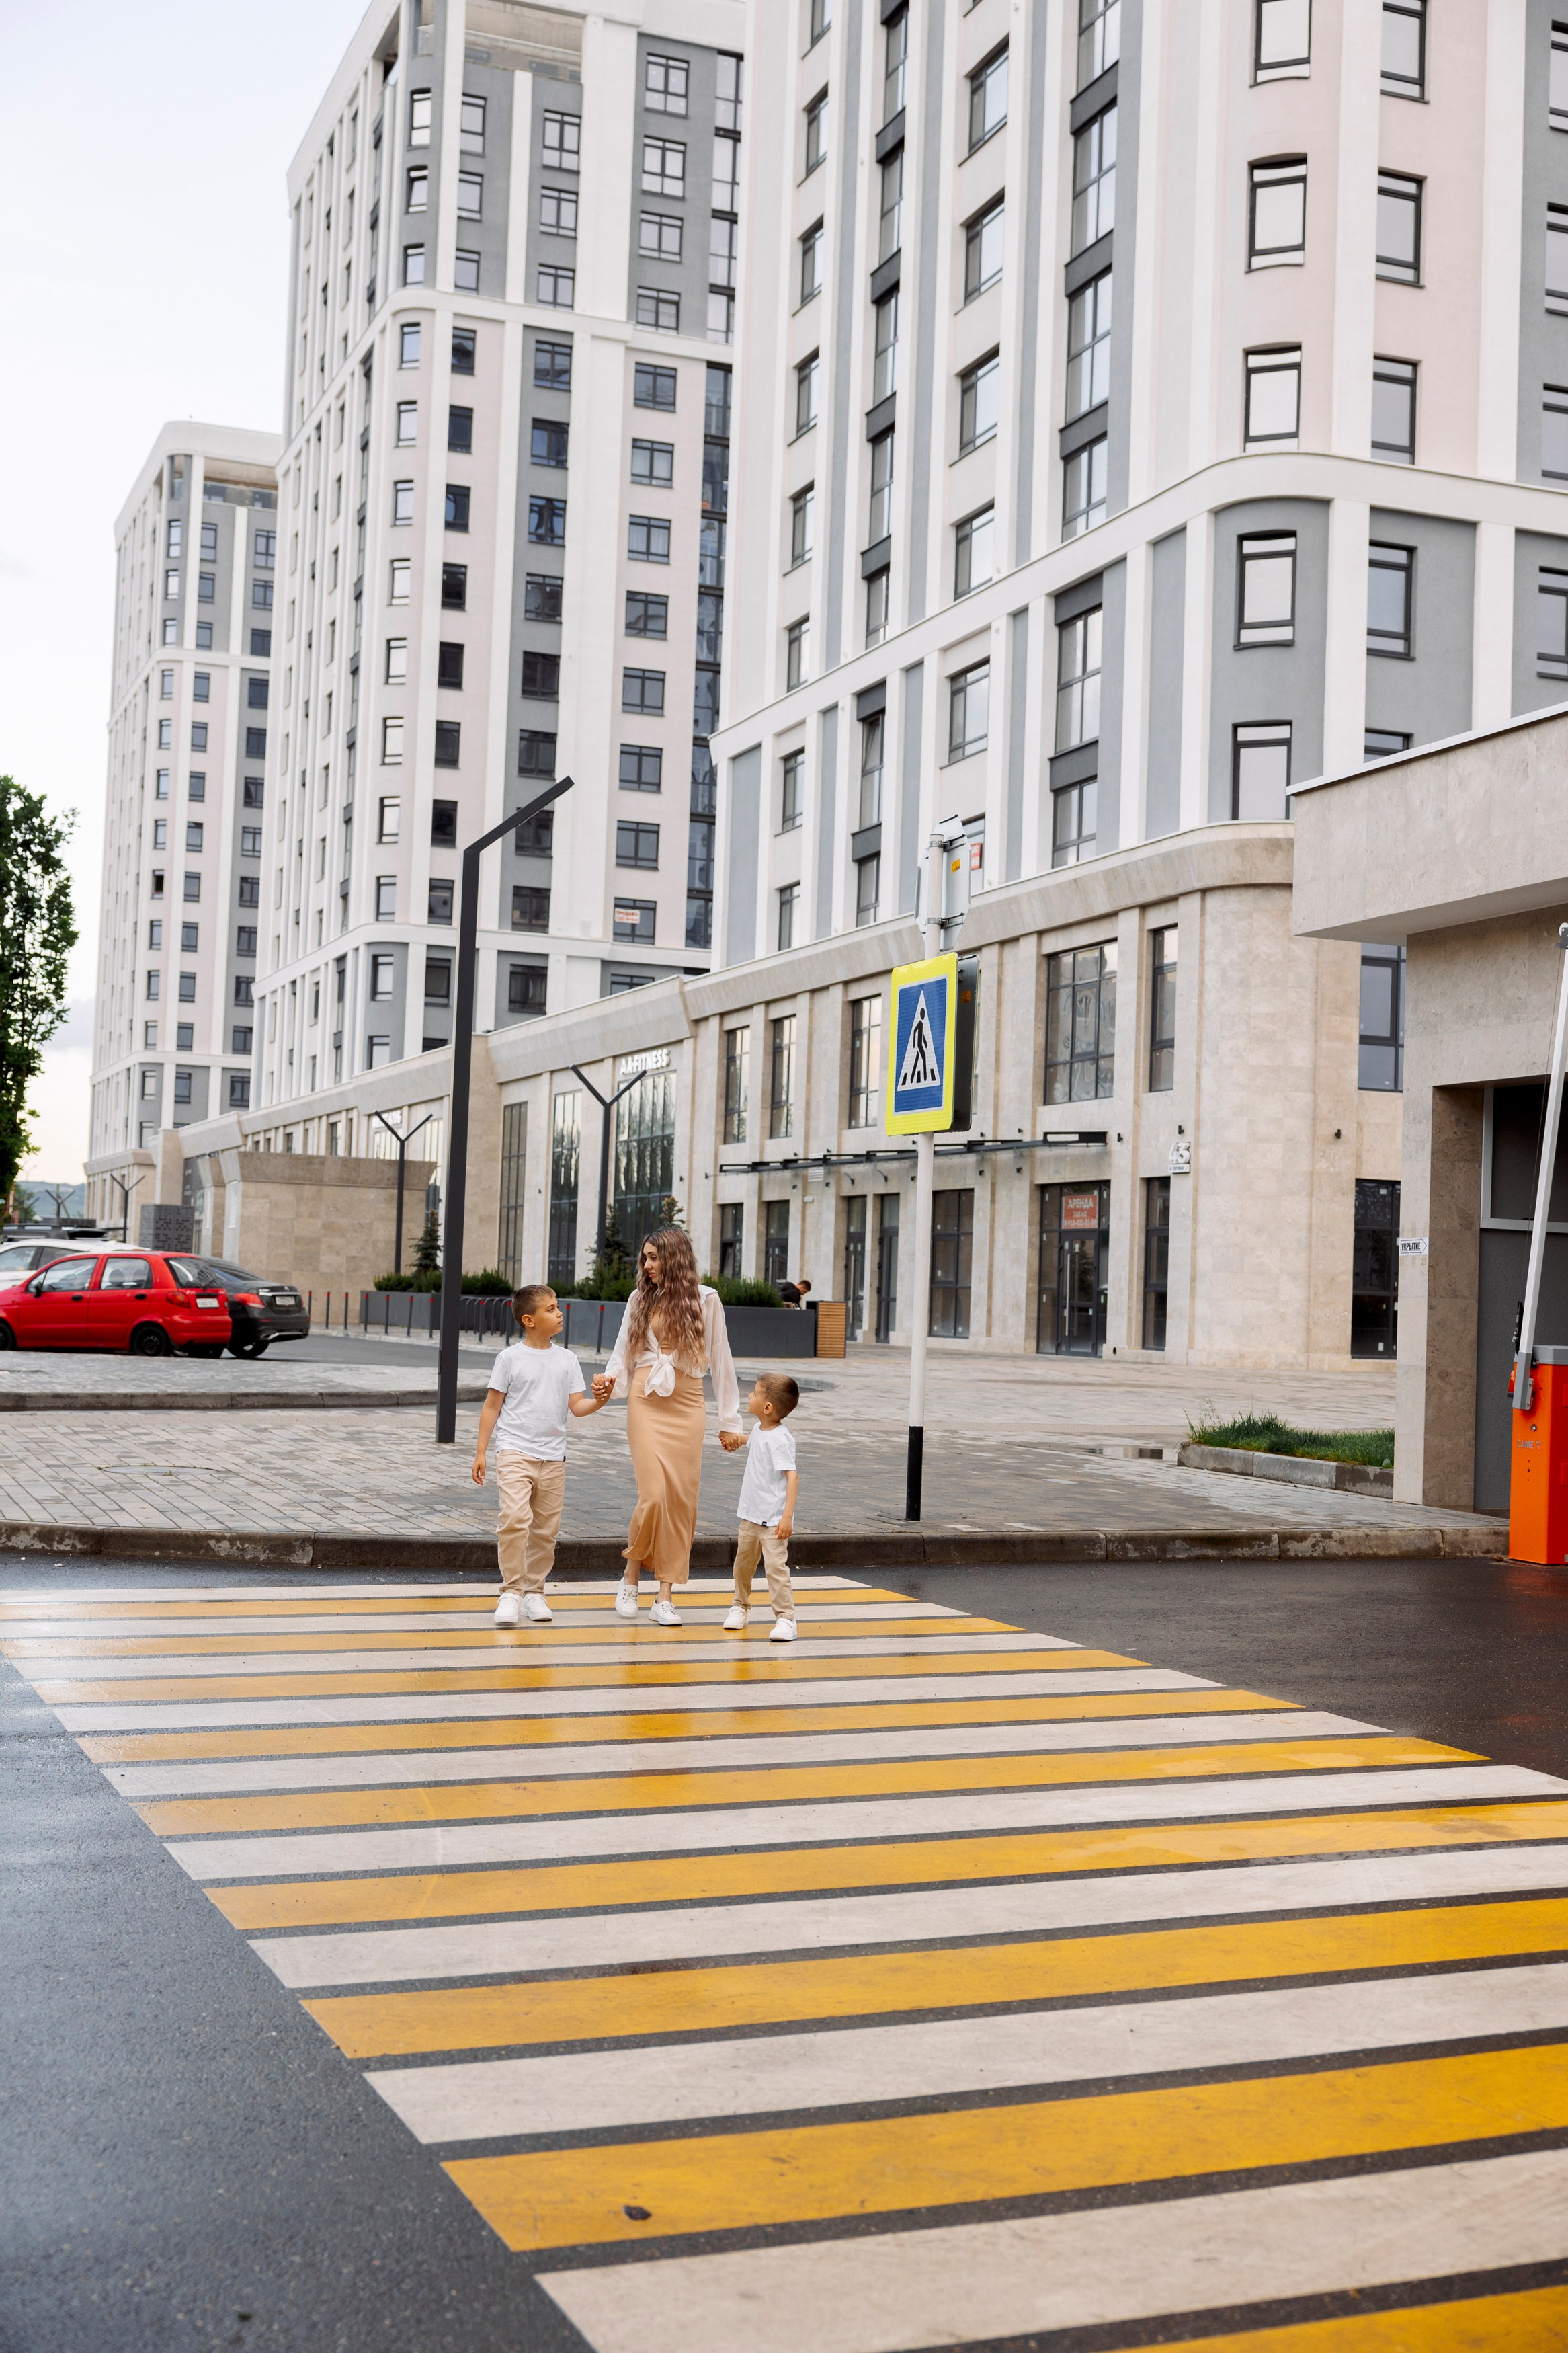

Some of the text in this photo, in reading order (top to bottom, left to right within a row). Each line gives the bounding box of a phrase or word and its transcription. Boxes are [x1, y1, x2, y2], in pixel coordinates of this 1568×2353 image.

[1169, 1142, 1191, 1164] 43
[1067, 1197, 1094, 1209] АРЕНДА
[1401, 1242, 1420, 1250] УКРЫТИЕ
[1517, 1439, 1534, 1449] CAME
